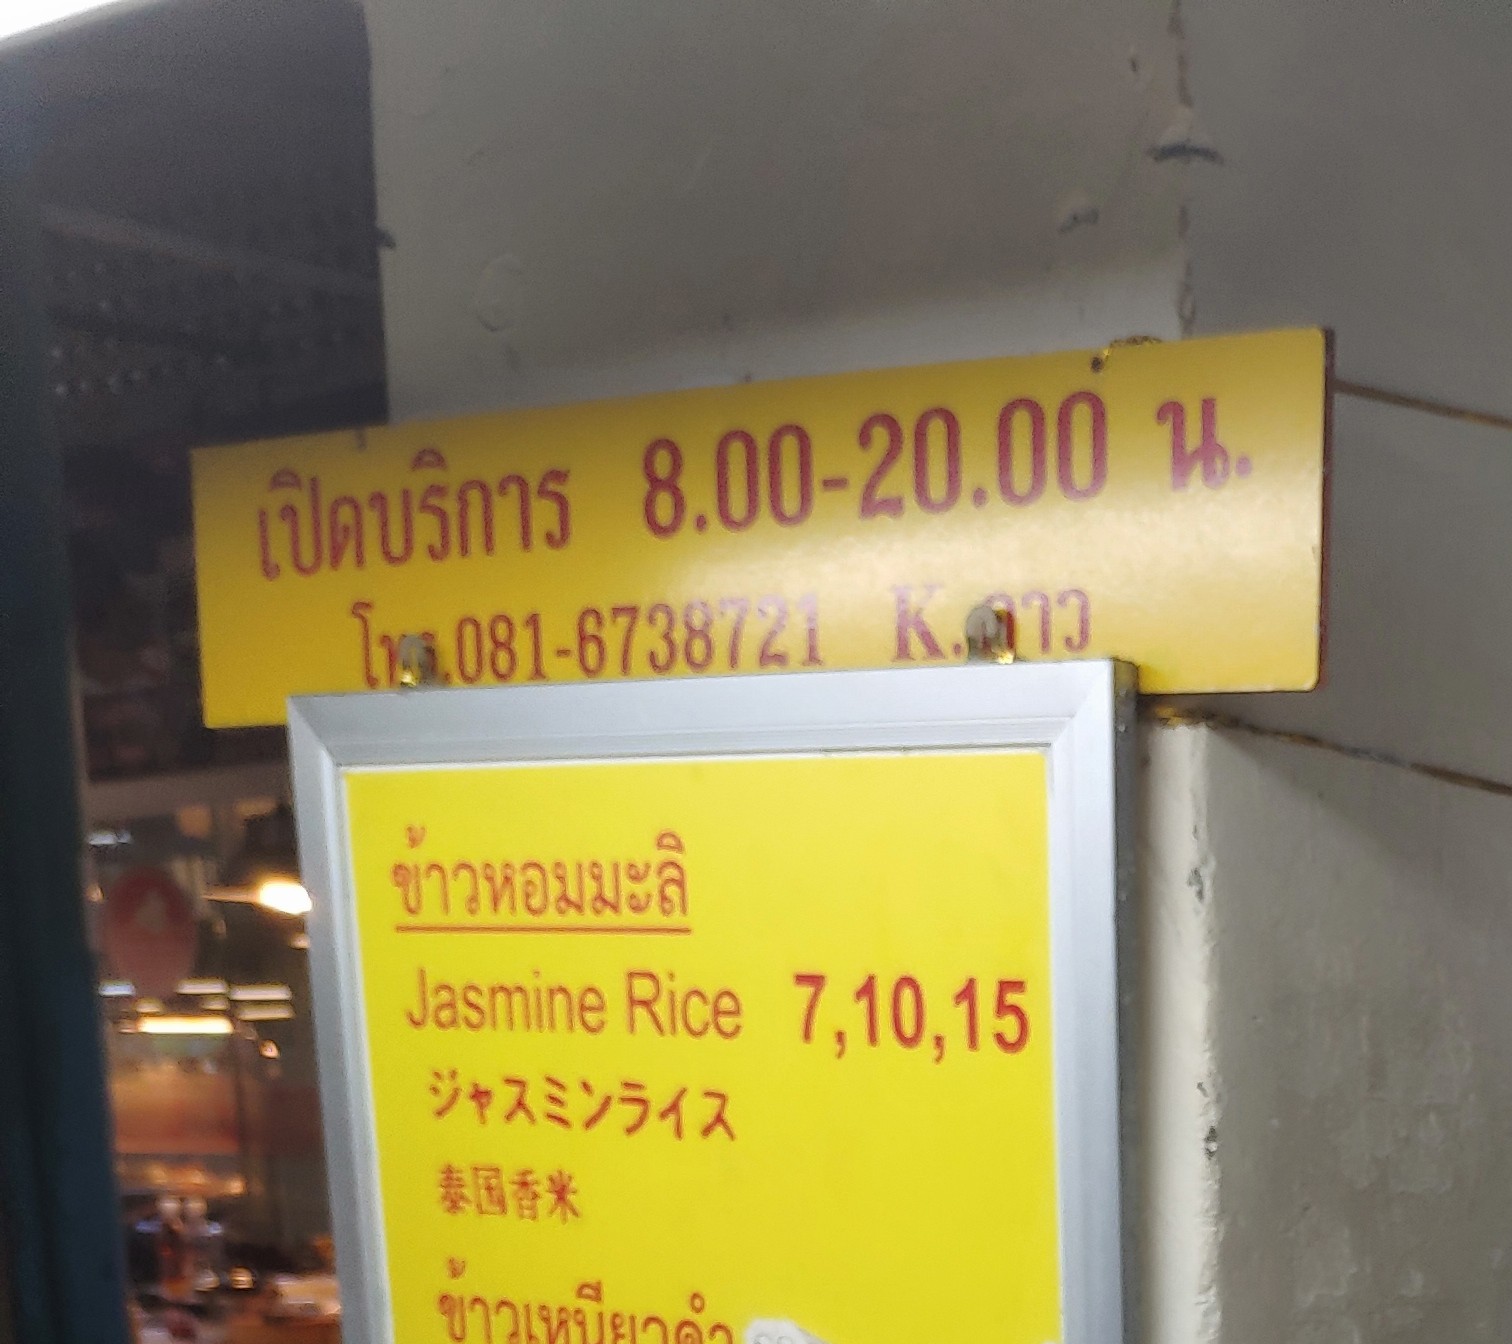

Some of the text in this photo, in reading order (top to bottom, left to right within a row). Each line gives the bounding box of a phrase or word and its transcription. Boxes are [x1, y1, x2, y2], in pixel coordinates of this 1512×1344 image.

[258, 388, 1253, 580] เปิดบริการ 8.00-20.00 น.
[391, 824, 688, 919] ข้าวหอมมะลิ
[407, 967, 1030, 1063] Jasmine Rice 7,10,15
[427, 1069, 736, 1142] ジャスミンライス
[439, 1164, 581, 1225] 泰国香米
